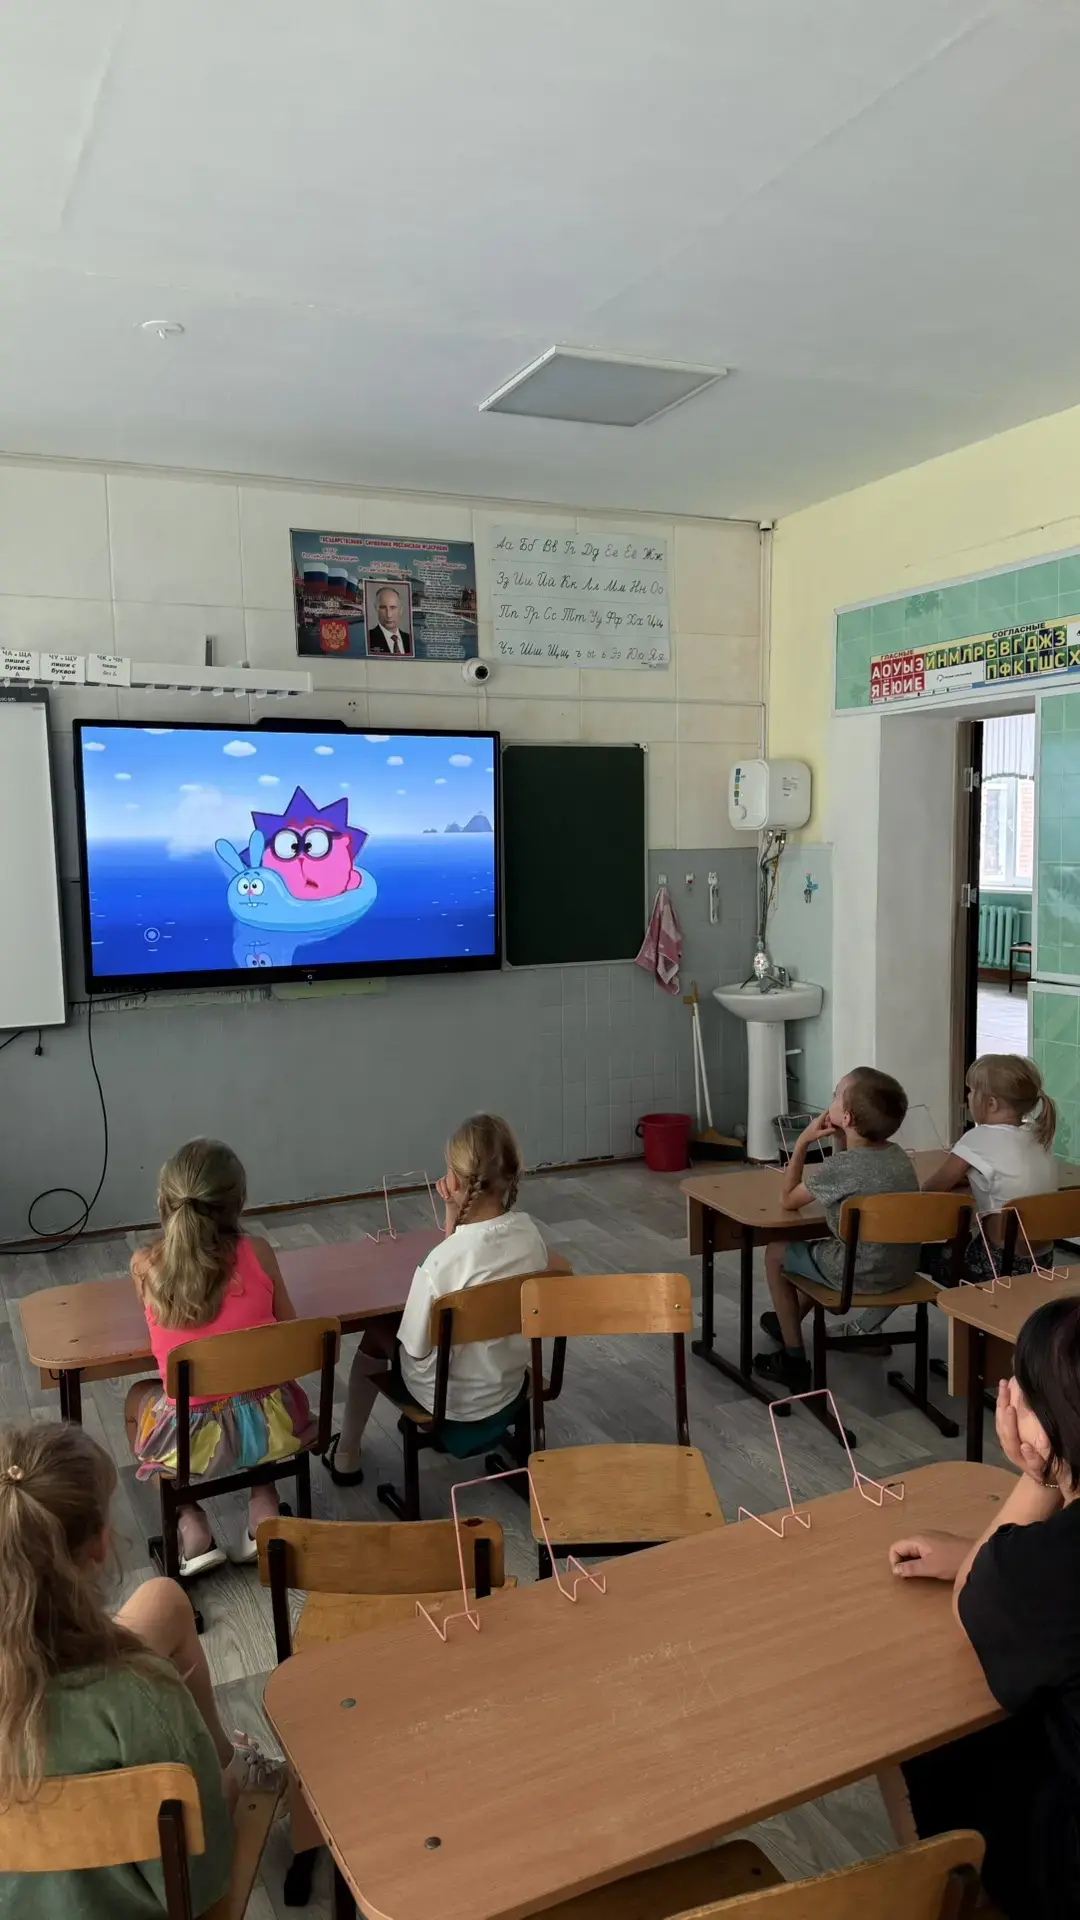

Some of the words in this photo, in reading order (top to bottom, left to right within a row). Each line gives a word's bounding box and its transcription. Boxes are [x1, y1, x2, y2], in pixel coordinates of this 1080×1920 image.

[494, 536, 514, 551] Аа
[519, 537, 538, 552] Бб
[542, 538, 558, 553] Вв
[564, 540, 576, 555] Гг
[581, 542, 600, 561] Дд
[642, 547, 663, 561] Жж
[496, 571, 510, 589] Зз
[514, 573, 533, 586] Ии
[537, 571, 556, 588] Йй
[560, 574, 578, 589] Кк
[582, 577, 600, 591] Лл
[603, 579, 626, 592] Мм
[629, 579, 647, 594] Нн
[650, 580, 664, 595] Оо
[498, 604, 519, 619] Пп
[523, 605, 539, 625] Рр
[543, 607, 557, 621] Сс
[561, 607, 587, 622] Тт
[589, 609, 603, 629] Уу
[605, 610, 623, 629] Фф
[626, 613, 643, 626] Хх
[647, 614, 664, 629] Цц
[992, 622, 1046, 639] СОГЛАСНЫЕ
[498, 641, 514, 655] Чч
[520, 641, 543, 656] Шш
[548, 644, 570, 659] Щщ
[610, 647, 621, 659] Ээ
[626, 647, 645, 660] Юю
[648, 648, 665, 661] Яя
[880, 649, 914, 661] ГЛАСНЫЕ
[50, 667, 77, 675] буквой
